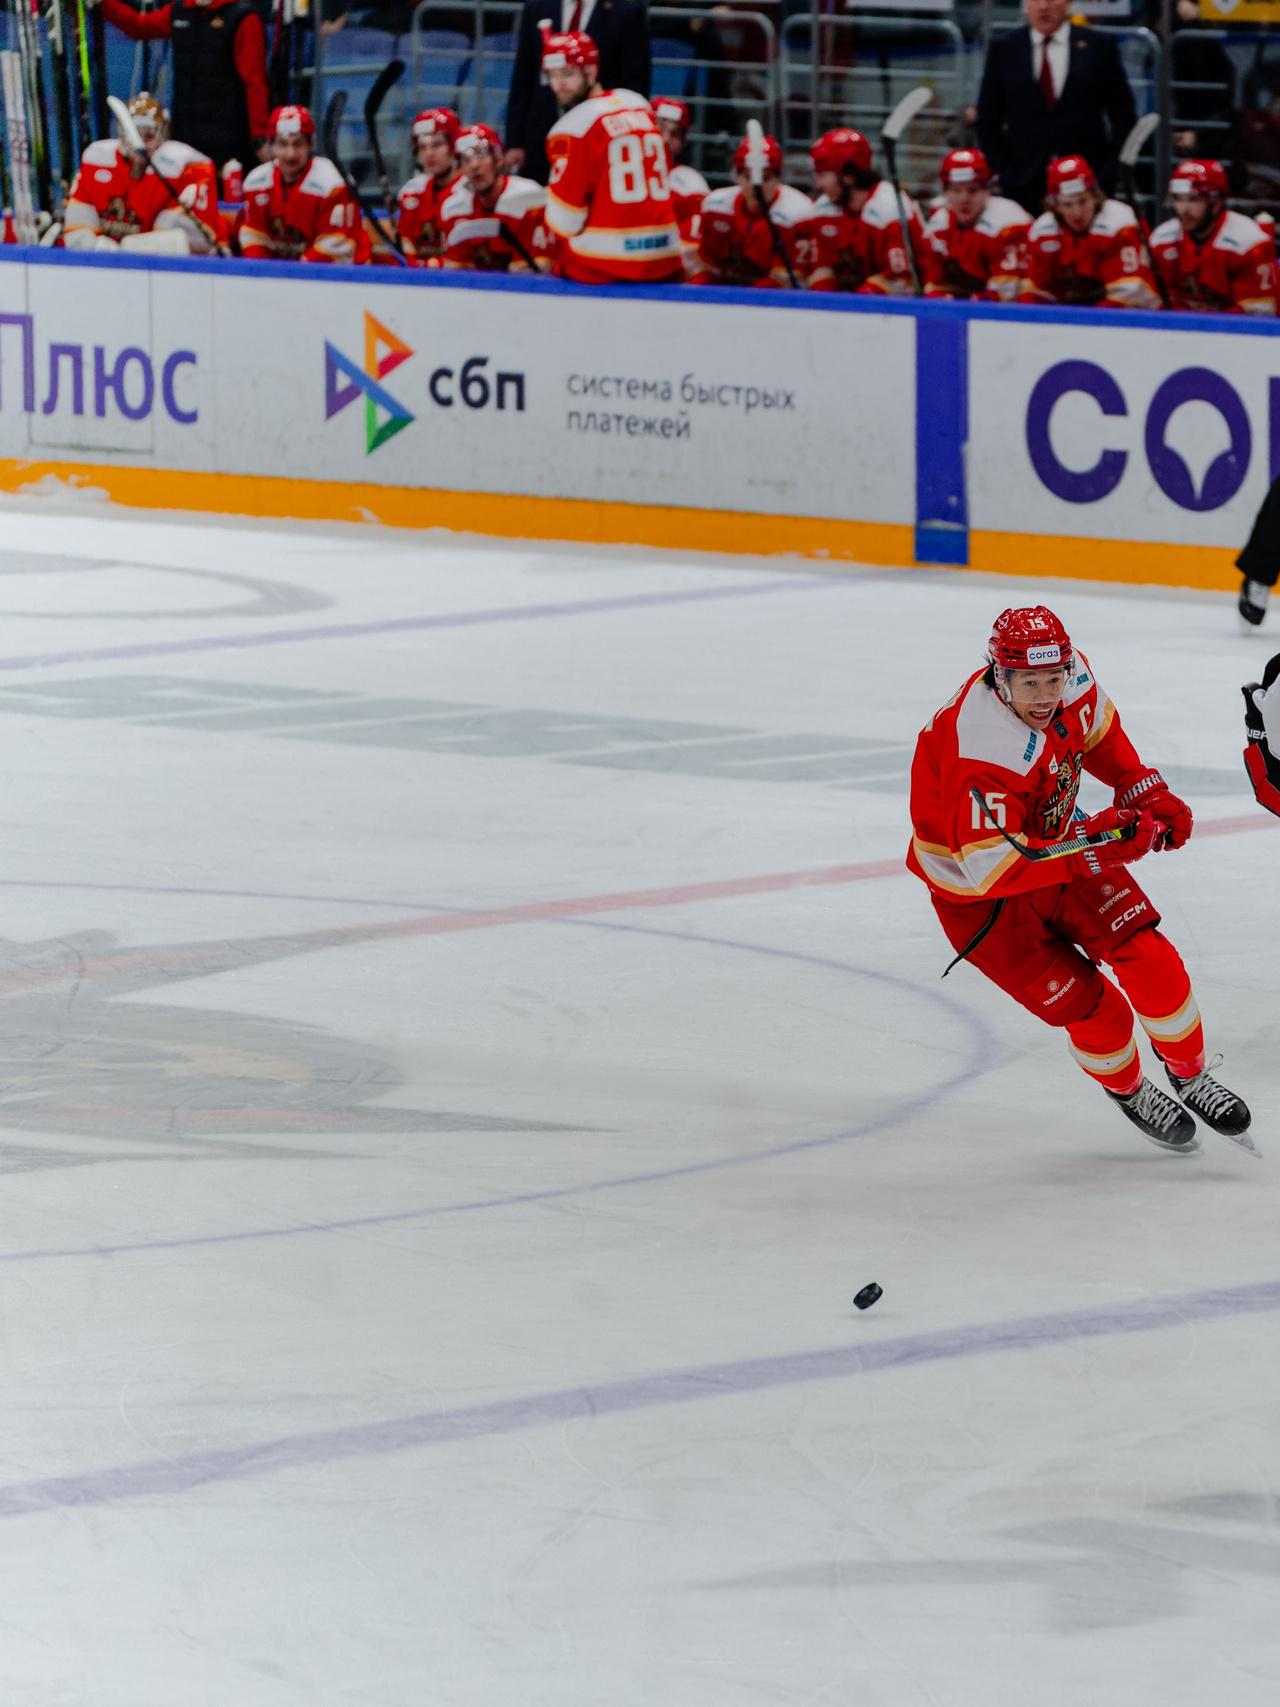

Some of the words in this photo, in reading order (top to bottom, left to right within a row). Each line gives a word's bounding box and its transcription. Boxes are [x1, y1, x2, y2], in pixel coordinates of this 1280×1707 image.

[608, 132, 672, 205] 83
[428, 356, 526, 412] сбп
[566, 373, 673, 403] система
[680, 374, 797, 414] быстрых
[566, 410, 692, 440] платежей
[1022, 731, 1039, 763] SIBUR
[968, 792, 1008, 831] 15
[1098, 887, 1132, 915] ГАЗПРОМБАНК
[1110, 900, 1148, 932] CCM
[1042, 976, 1076, 1007] ГАЗПРОМБАНК
